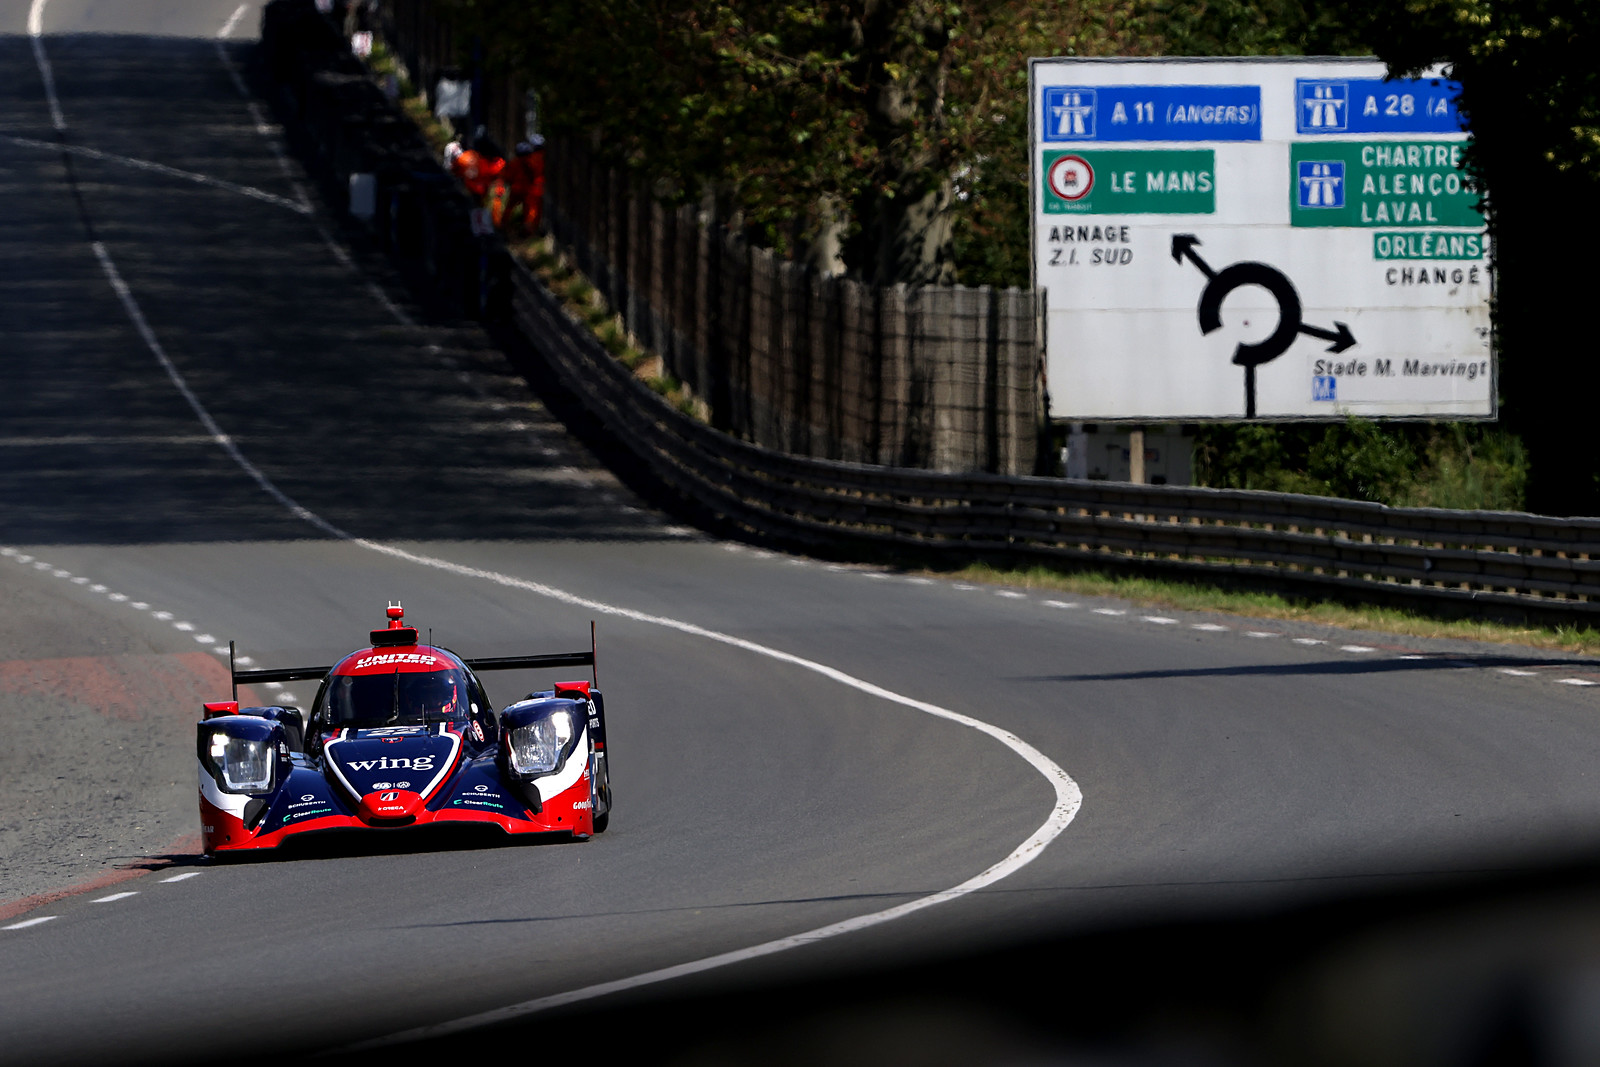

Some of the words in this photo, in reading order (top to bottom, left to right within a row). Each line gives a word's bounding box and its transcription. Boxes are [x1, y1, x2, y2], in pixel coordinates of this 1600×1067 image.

[1111, 102, 1128, 124] A
[1133, 102, 1154, 123] 11
[1166, 104, 1257, 125] (ANGERS)
[1363, 95, 1379, 116] A
[1384, 94, 1415, 116] 28
[1361, 145, 1460, 168] CHARTRE
[1111, 171, 1136, 193] LE
[1147, 171, 1213, 193] MANS
[1361, 201, 1438, 222] LAVAL
[1049, 226, 1130, 244] ARNAGE
[1377, 232, 1480, 257] ORLÉANS
[1049, 249, 1080, 266] Z.I.
[1090, 248, 1134, 266] SUD
[1385, 265, 1480, 286] CHANGÉ
[1313, 358, 1367, 377] Stade
[1373, 360, 1396, 377] M.
[1402, 358, 1487, 381] Marvingt
[357, 653, 436, 664] UNITED
[346, 755, 435, 771] wing
